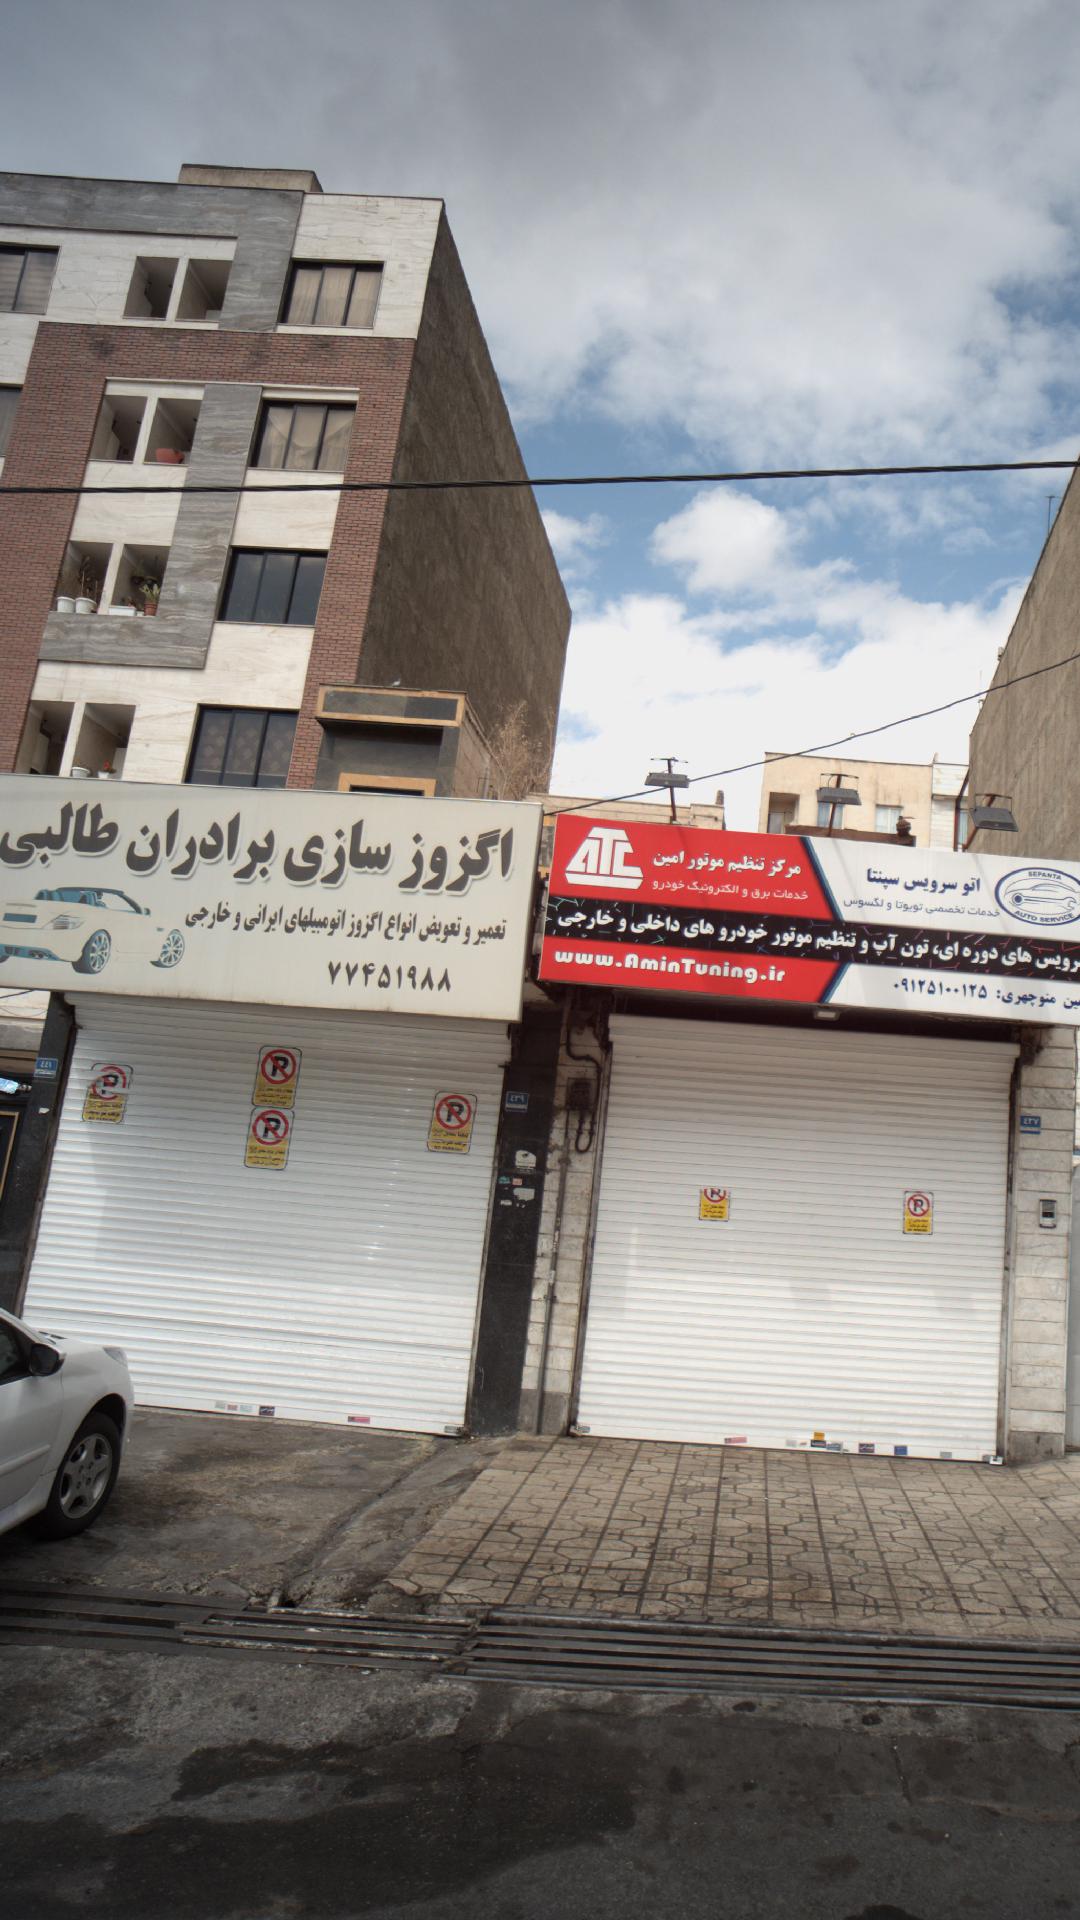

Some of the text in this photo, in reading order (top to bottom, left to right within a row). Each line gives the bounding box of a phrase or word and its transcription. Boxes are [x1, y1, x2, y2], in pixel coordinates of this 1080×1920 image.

[0, 801, 514, 892] اگزوز سازی برادران طالبی
[565, 826, 644, 880] ATC
[653, 850, 801, 878] مرکز تنظیم موتور امین
[867, 868, 981, 896] اتو سرویس سپنتا
[1028, 871, 1062, 880] SEPANTA
[652, 879, 809, 900] خدمات برق و الکترونیک خودرو
[886, 902, 893, 911] و
[895, 900, 923, 912] تویوتا
[925, 905, 965, 914] تخصصی
[967, 907, 1001, 917] خدمات
[1014, 910, 1038, 921] AUTO
[185, 900, 507, 946] تعمیر و تعویض انواع اگزوز اتومبیلهای ایرانی و خارجی
[558, 909, 614, 930] خارجی
[617, 917, 627, 932] و
[630, 913, 681, 934] داخلی
[683, 918, 715, 938] های
[717, 922, 768, 944] خودرو
[771, 926, 813, 948] موتور
[815, 930, 857, 949] تنظیم
[859, 939, 869, 954] و
[872, 933, 899, 957] آپ
[901, 939, 930, 958] تون
[962, 947, 999, 964] دوره
[555, 950, 786, 984] www.AminTuning.ir
[1001, 946, 1032, 967] های
[327, 959, 452, 993] ۷۷۴۵۱۹۸۸
